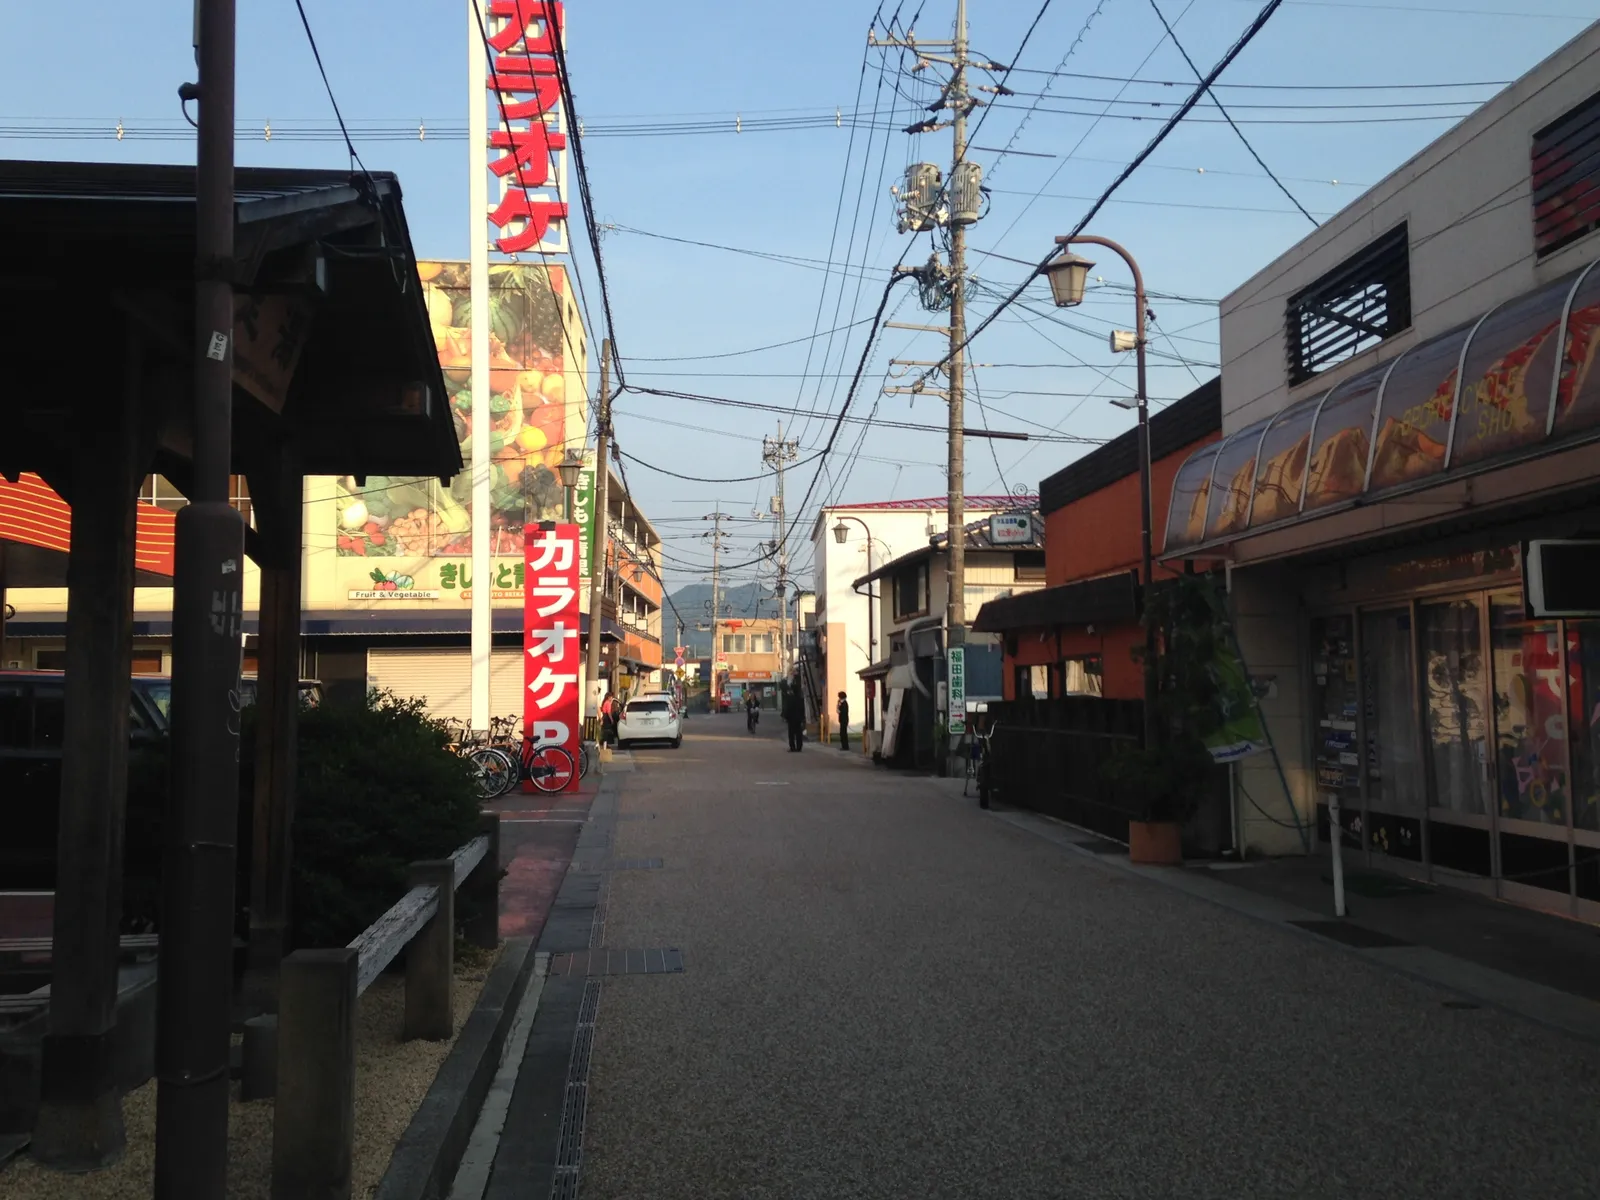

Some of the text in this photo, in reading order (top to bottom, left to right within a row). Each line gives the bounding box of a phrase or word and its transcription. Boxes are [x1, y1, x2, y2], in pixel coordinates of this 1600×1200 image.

[487, 0, 568, 254] カラオケ
[528, 531, 577, 710] カラオケ
[951, 650, 963, 700] 福田歯科
[533, 721, 570, 757] P
